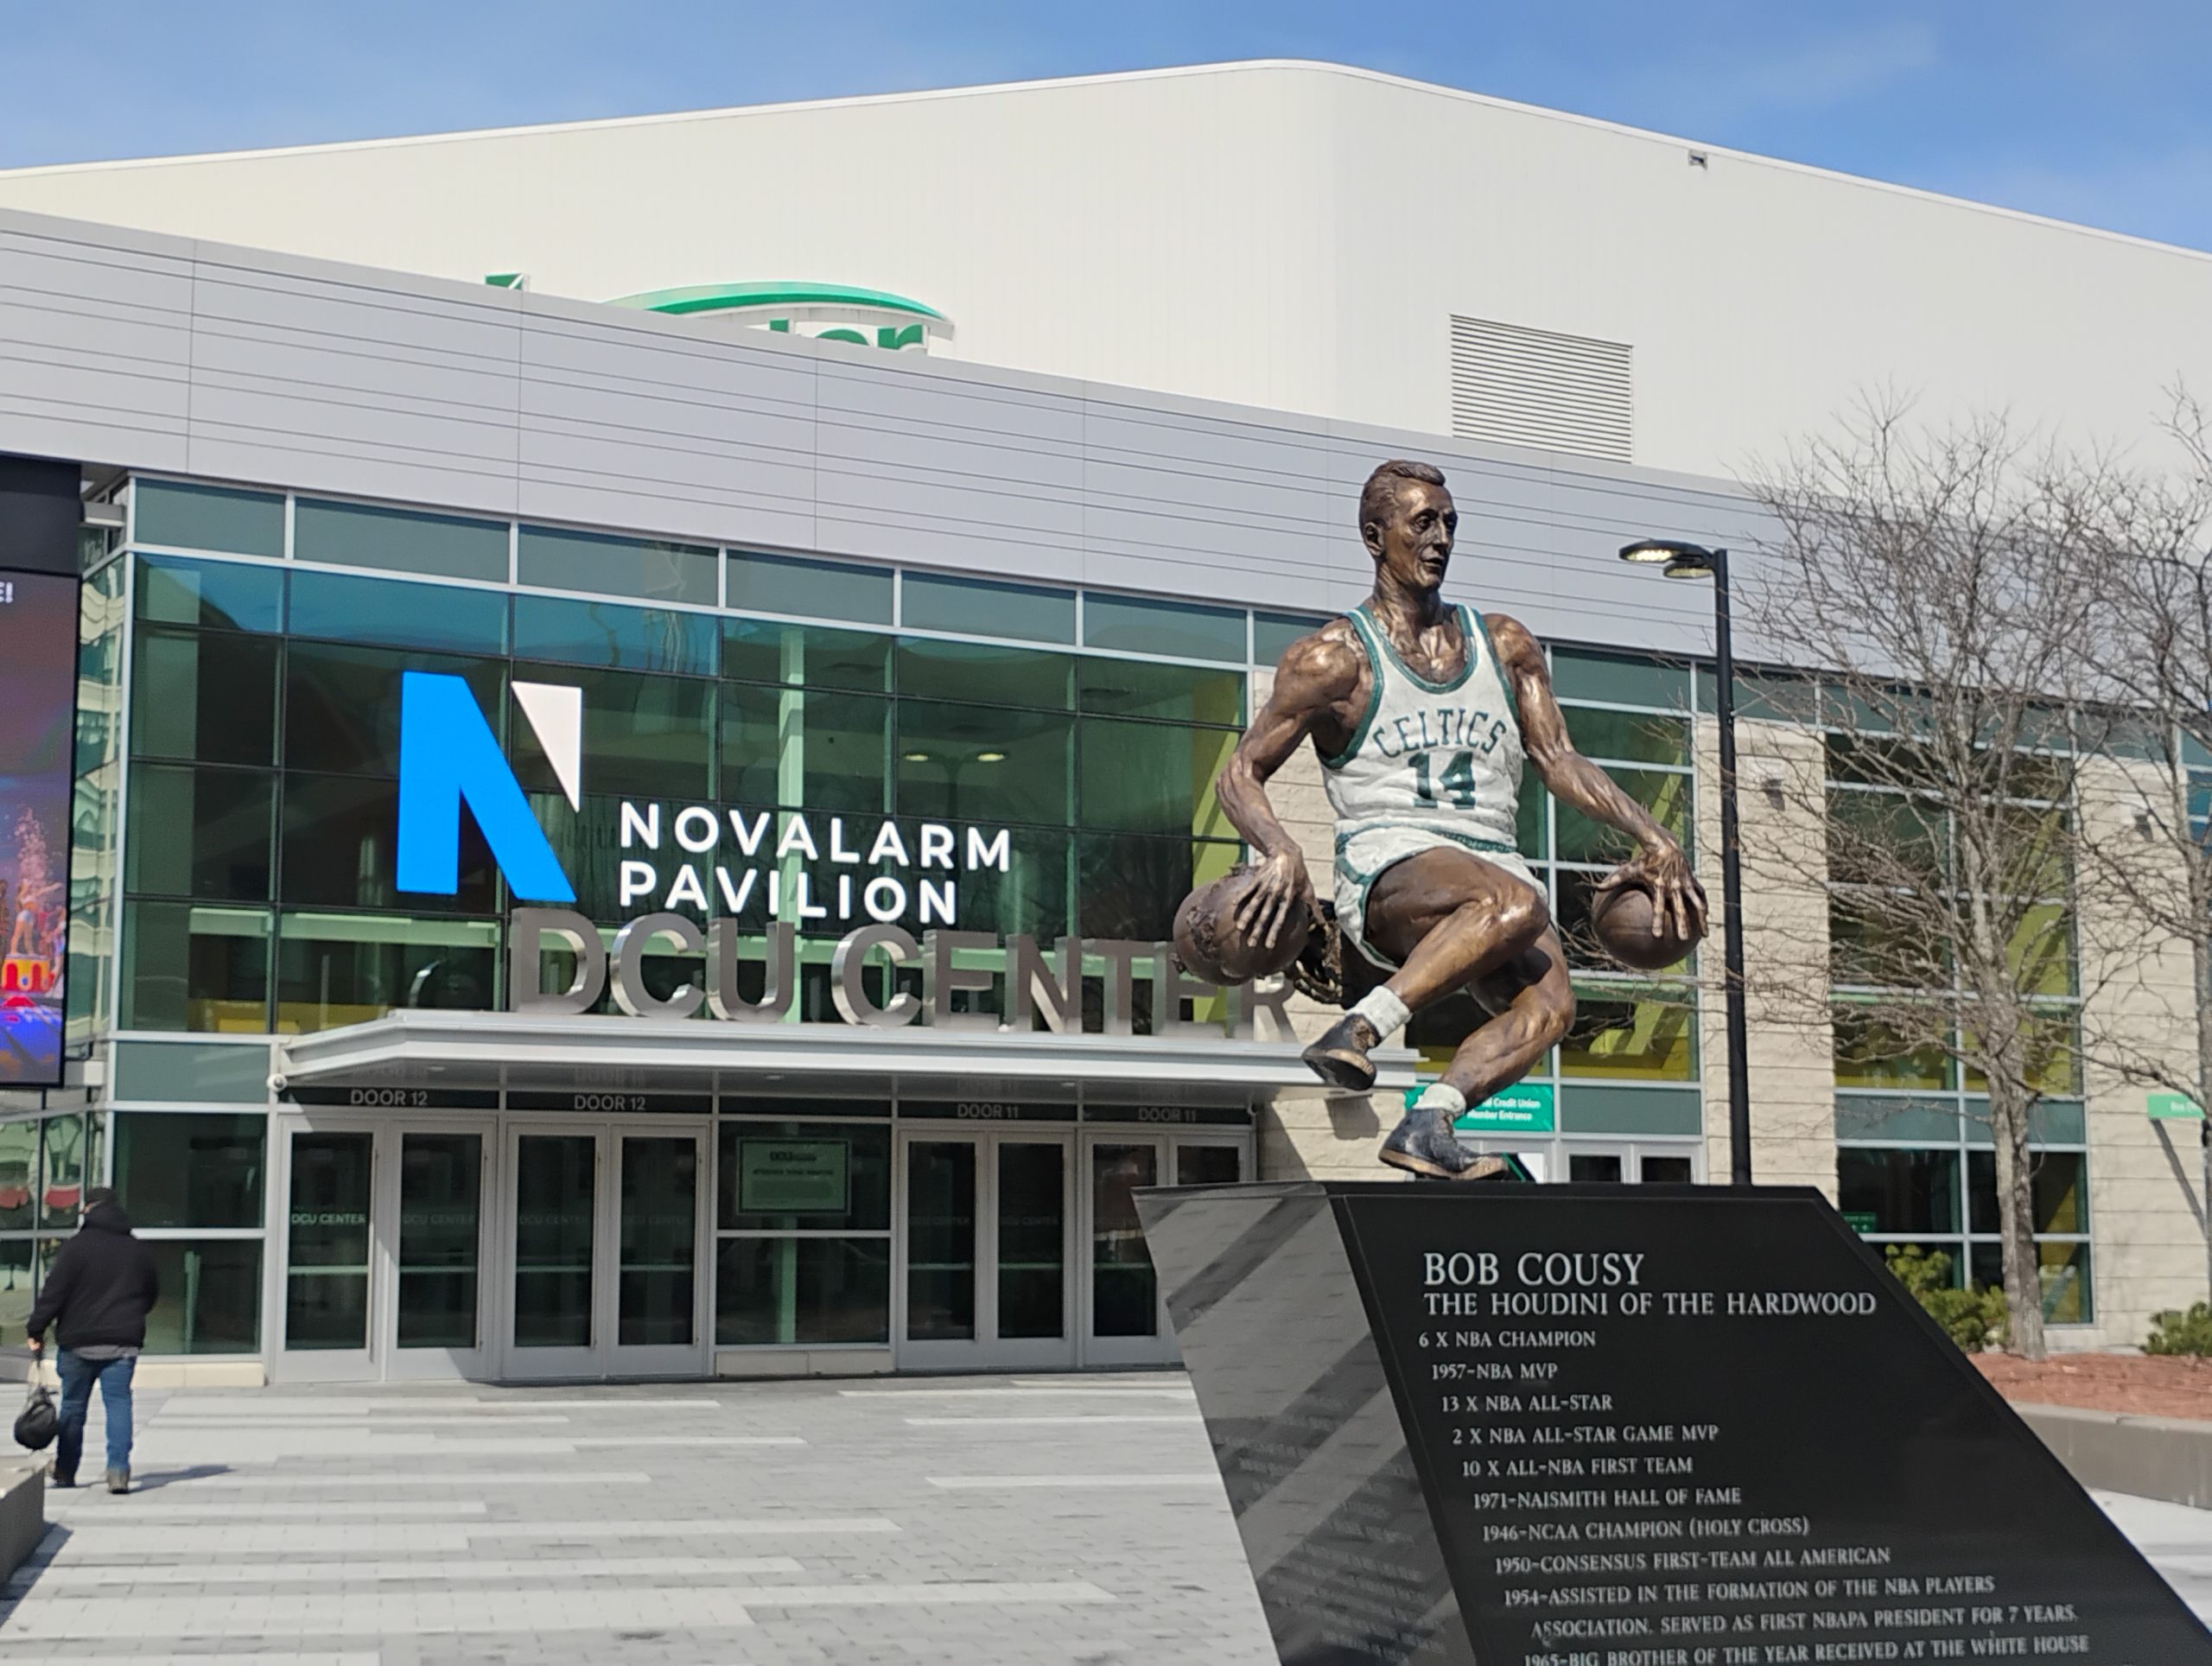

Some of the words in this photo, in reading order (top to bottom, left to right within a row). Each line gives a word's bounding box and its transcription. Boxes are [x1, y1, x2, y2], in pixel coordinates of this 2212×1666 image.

[1372, 707, 1507, 758] CELTICS
[1408, 751, 1477, 810] 14
[620, 800, 1011, 873] NOVALARM
[620, 861, 957, 925] PAVILION
[510, 906, 796, 1023] DCU
[350, 1089, 406, 1106] DOOR
[411, 1091, 429, 1106] 12
[574, 1095, 626, 1111] DOOR
[631, 1096, 646, 1111] 12
[1493, 1097, 1516, 1108] Credit
[1518, 1098, 1541, 1110] Union
[957, 1103, 1001, 1118] DOOR
[1007, 1105, 1019, 1118] 11
[1138, 1107, 1181, 1122] DOOR
[1184, 1109, 1197, 1122] 11
[1499, 1110, 1533, 1122] Entrance
[319, 1212, 366, 1224] CENTER
[1423, 1252, 1499, 1286] BOB
[1517, 1252, 1644, 1287] COUSY
[1423, 1292, 1478, 1316] THE
[1491, 1292, 1608, 1316] HOUDINI
[1619, 1292, 1653, 1315] OF
[1662, 1292, 1714, 1315] THE
[1726, 1292, 1877, 1316] HARDWOOD
[1418, 1332, 1430, 1348] 6
[1435, 1331, 1449, 1348] X
[1455, 1331, 1493, 1348] NBA
[1497, 1331, 1596, 1348] CHAMPION
[1432, 1363, 1514, 1381] 1957-NBA
[1520, 1363, 1558, 1380] MVP
[1442, 1396, 1460, 1413] 13
[1465, 1396, 1479, 1412] X
[1485, 1395, 1522, 1412] NBA
[1529, 1394, 1613, 1412] ALL-STAR
[1452, 1428, 1463, 1446] 2
[1470, 1428, 1483, 1445] X
[1489, 1427, 1526, 1444] NBA
[1531, 1426, 1617, 1444] ALL-STAR
[1622, 1425, 1674, 1443] GAME
[1681, 1424, 1719, 1441] MVP
[1463, 1460, 1481, 1478] 10
[1487, 1459, 1500, 1477] X
[1506, 1459, 1585, 1477] ALL-NBA
[1591, 1457, 1638, 1475] FIRST
[1643, 1456, 1694, 1475] TEAM
[1473, 1490, 1606, 1510] 1971-NAISMITH
[1614, 1489, 1659, 1506] HALL
[1664, 1488, 1688, 1506] OF
[1695, 1487, 1742, 1505] FAME
[1483, 1523, 1580, 1542] 1946-NCAA
[1585, 1520, 1683, 1540] CHAMPION
[1689, 1517, 1742, 1538] (HOLY
[1746, 1516, 1810, 1537] CROSS)
[1496, 1553, 1647, 1575] 1950-CONSENSUS
[1653, 1550, 1757, 1570] FIRST-TEAM
[1764, 1549, 1795, 1567] ALL
[1799, 1547, 1891, 1567] AMERICAN
[1504, 1586, 1631, 1607] 1954-ASSISTED
[1637, 1585, 1657, 1603] IN
[1663, 1584, 1700, 1602] THE
[1707, 1580, 1808, 1600] FORMATION
[1815, 1580, 1836, 1597] OF
[1843, 1579, 1878, 1597] THE
[1885, 1578, 1920, 1595] NBA
[1925, 1575, 1995, 1594] PLAYERS
[1661, 1615, 1726, 1634] SERVED
[1732, 1614, 1754, 1632] AS
[1760, 1612, 1807, 1631] FIRST
[1813, 1611, 1868, 1629] NBAPA
[1874, 1607, 1965, 1627] PRESIDENT
[1971, 1606, 2004, 1625] FOR
[2008, 1606, 2018, 1624] 7
[1607, 1649, 1688, 1666] BROTHER
[1694, 1648, 1716, 1664] OF
[1722, 1646, 1758, 1664] THE
[1764, 1644, 1809, 1663] YEAR
[1815, 1641, 1897, 1661] RECEIVED
[1903, 1640, 1924, 1659] AT
[1930, 1639, 1964, 1657] THE
[1970, 1637, 2026, 1656] WHITE
[2033, 1635, 2089, 1654] HOUSE
